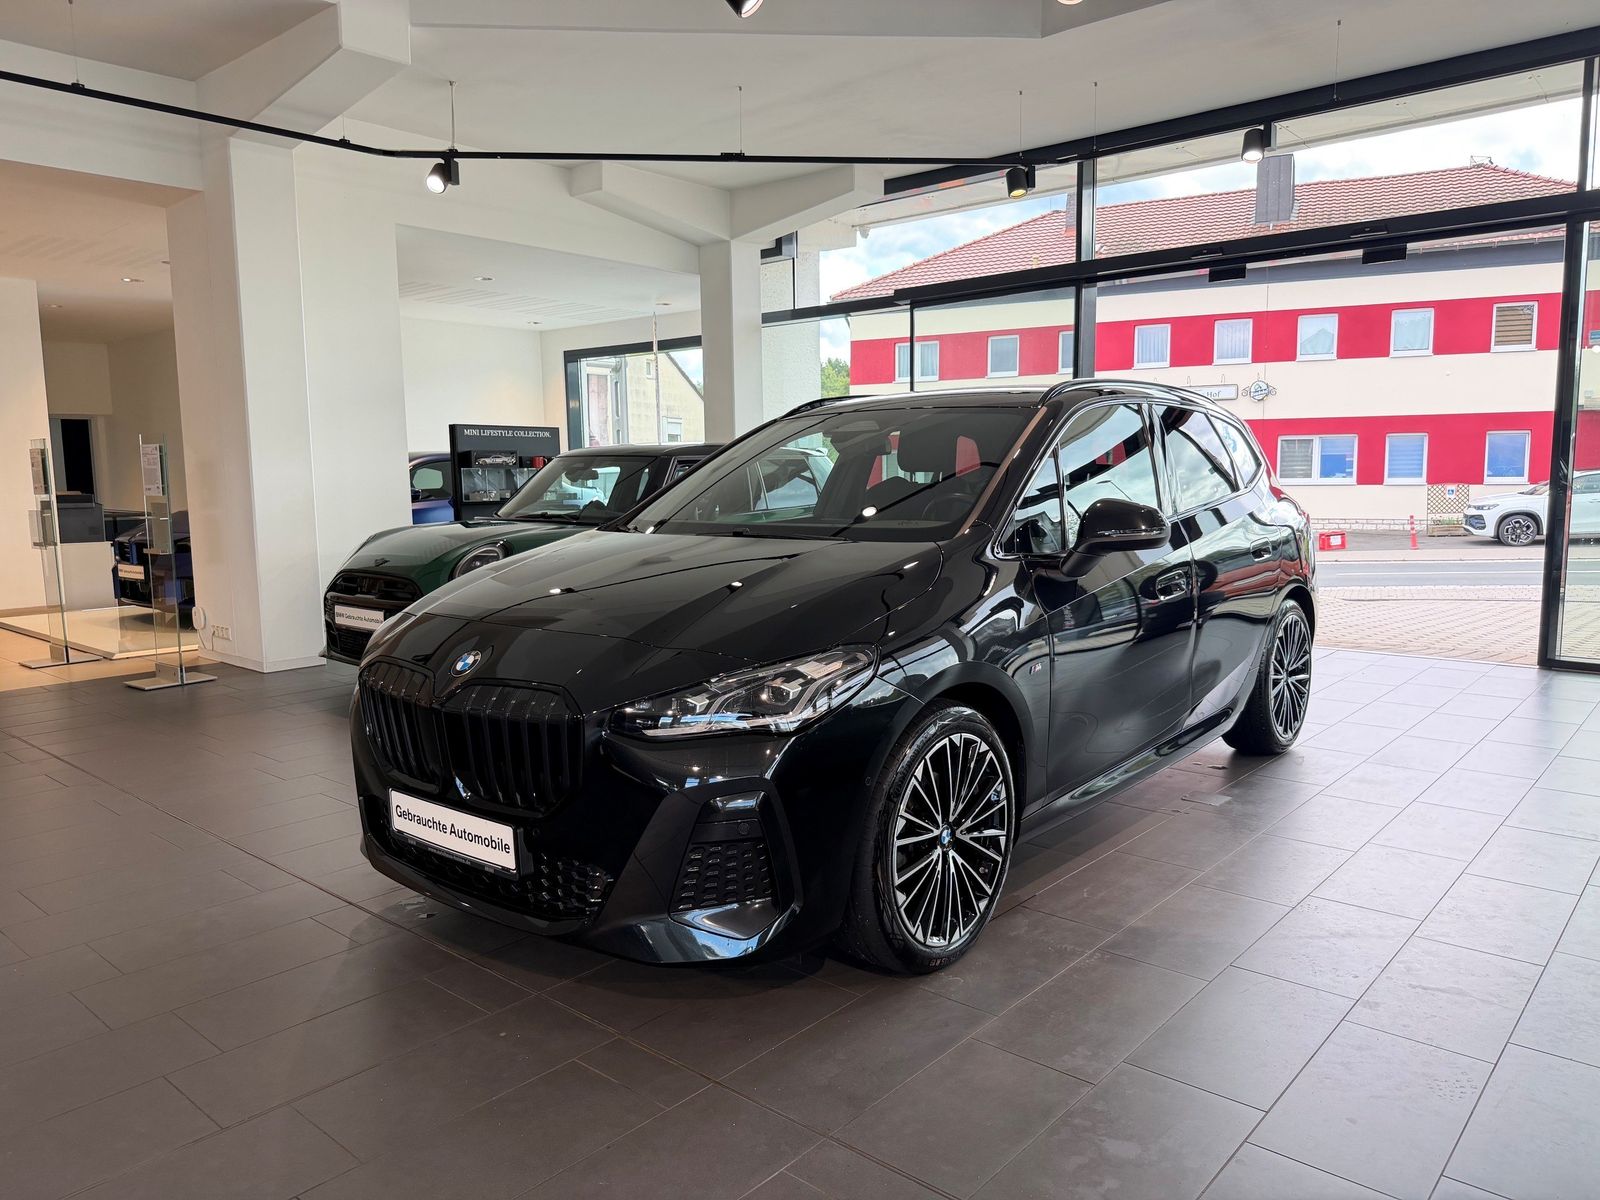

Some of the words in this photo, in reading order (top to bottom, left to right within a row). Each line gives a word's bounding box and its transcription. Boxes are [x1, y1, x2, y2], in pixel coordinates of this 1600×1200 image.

[480, 429, 514, 437] LIFESTYLE
[513, 430, 551, 438] COLLECTION.
[395, 804, 448, 834] Gebrauchte
[449, 823, 511, 854] Automobile
